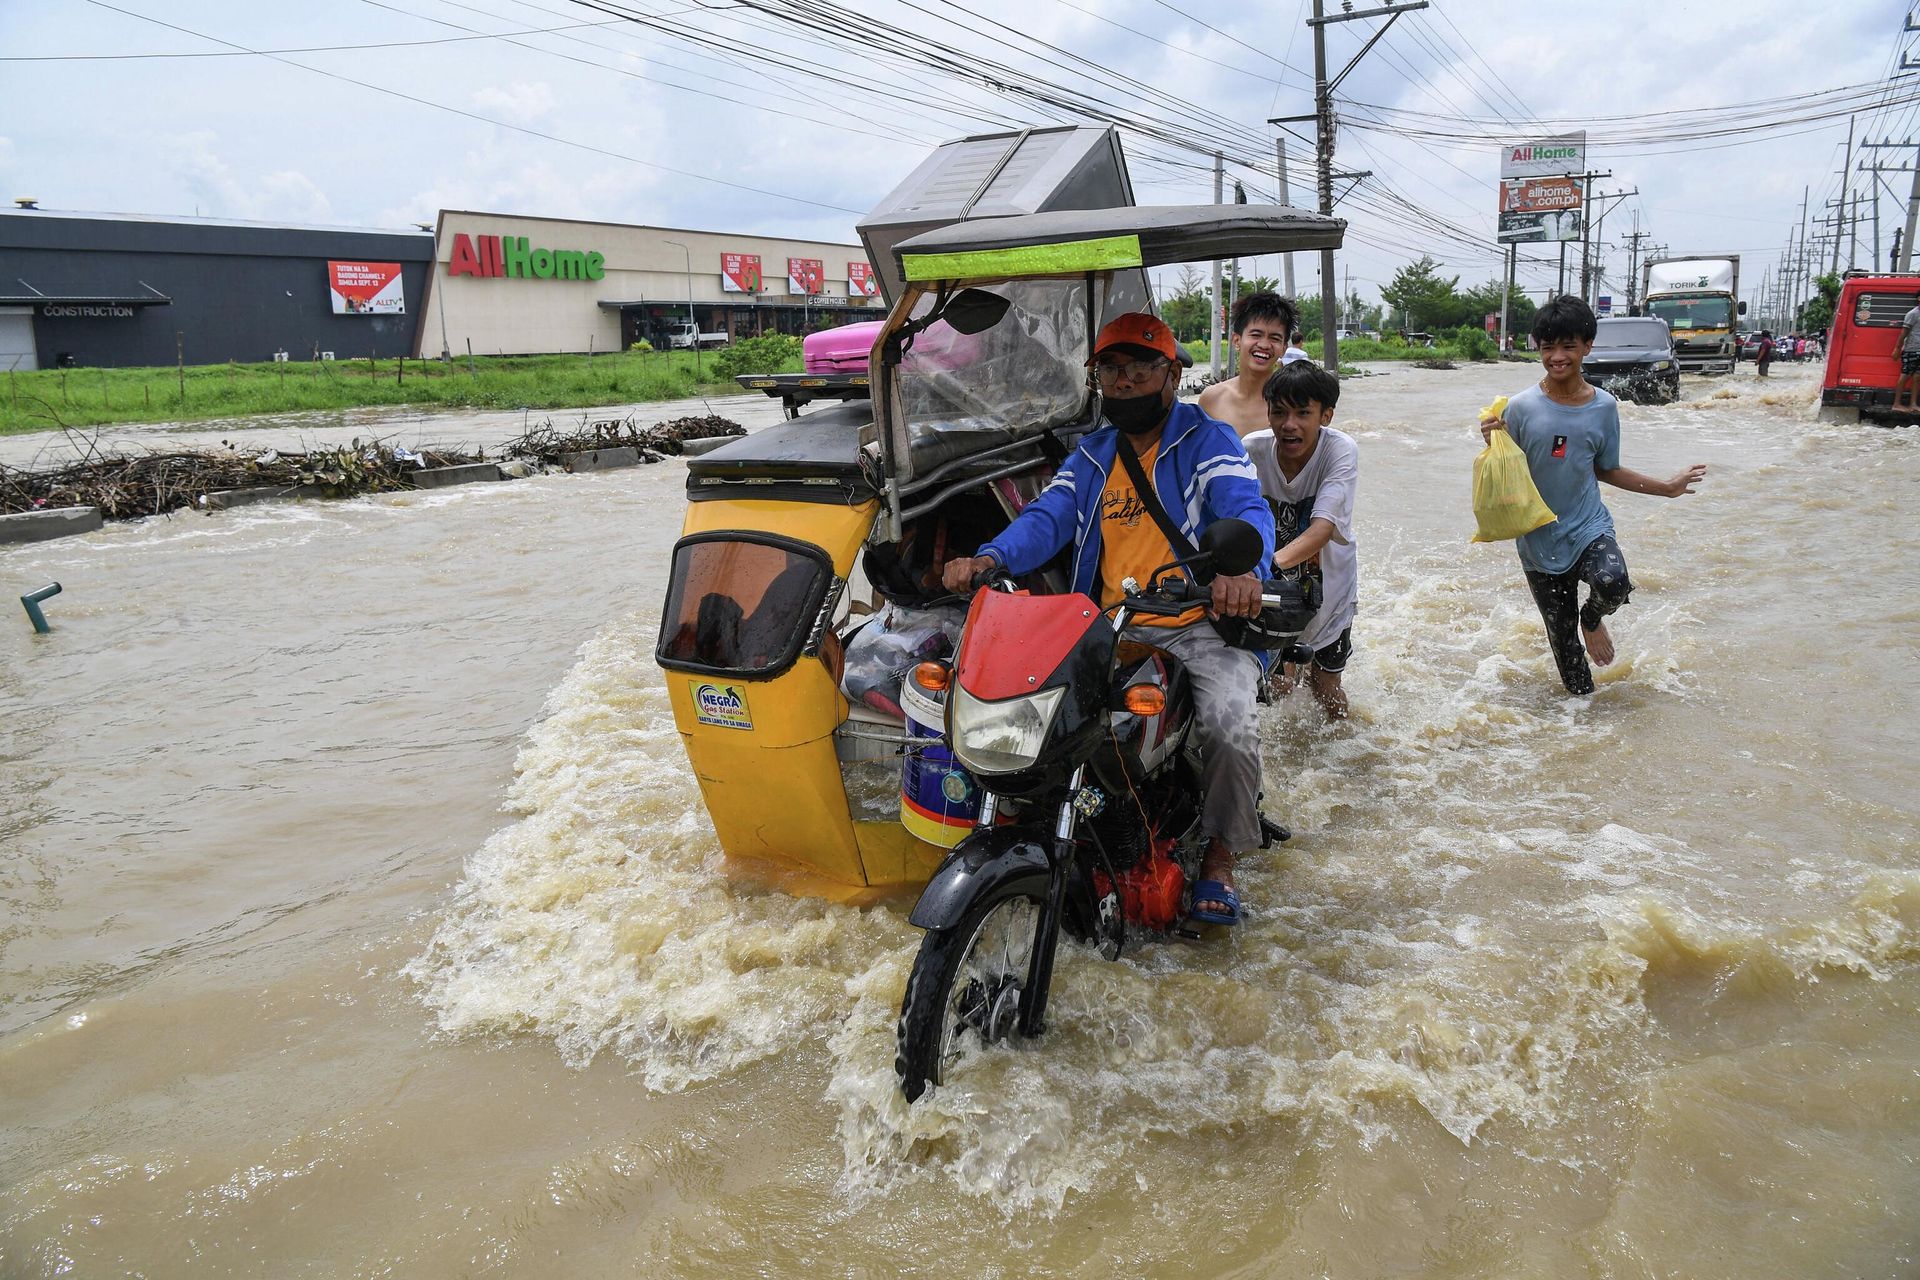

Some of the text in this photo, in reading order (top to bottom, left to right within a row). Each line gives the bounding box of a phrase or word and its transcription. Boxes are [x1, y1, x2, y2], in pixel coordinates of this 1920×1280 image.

[1511, 147, 1576, 161] AllHome
[1528, 187, 1571, 198] allhome
[1536, 195, 1578, 206] .com.ph
[448, 233, 606, 281] AllHome
[43, 306, 134, 317] CONSTRUCTION
[702, 694, 740, 708] NEGRA
[704, 704, 744, 716] Gas Station
